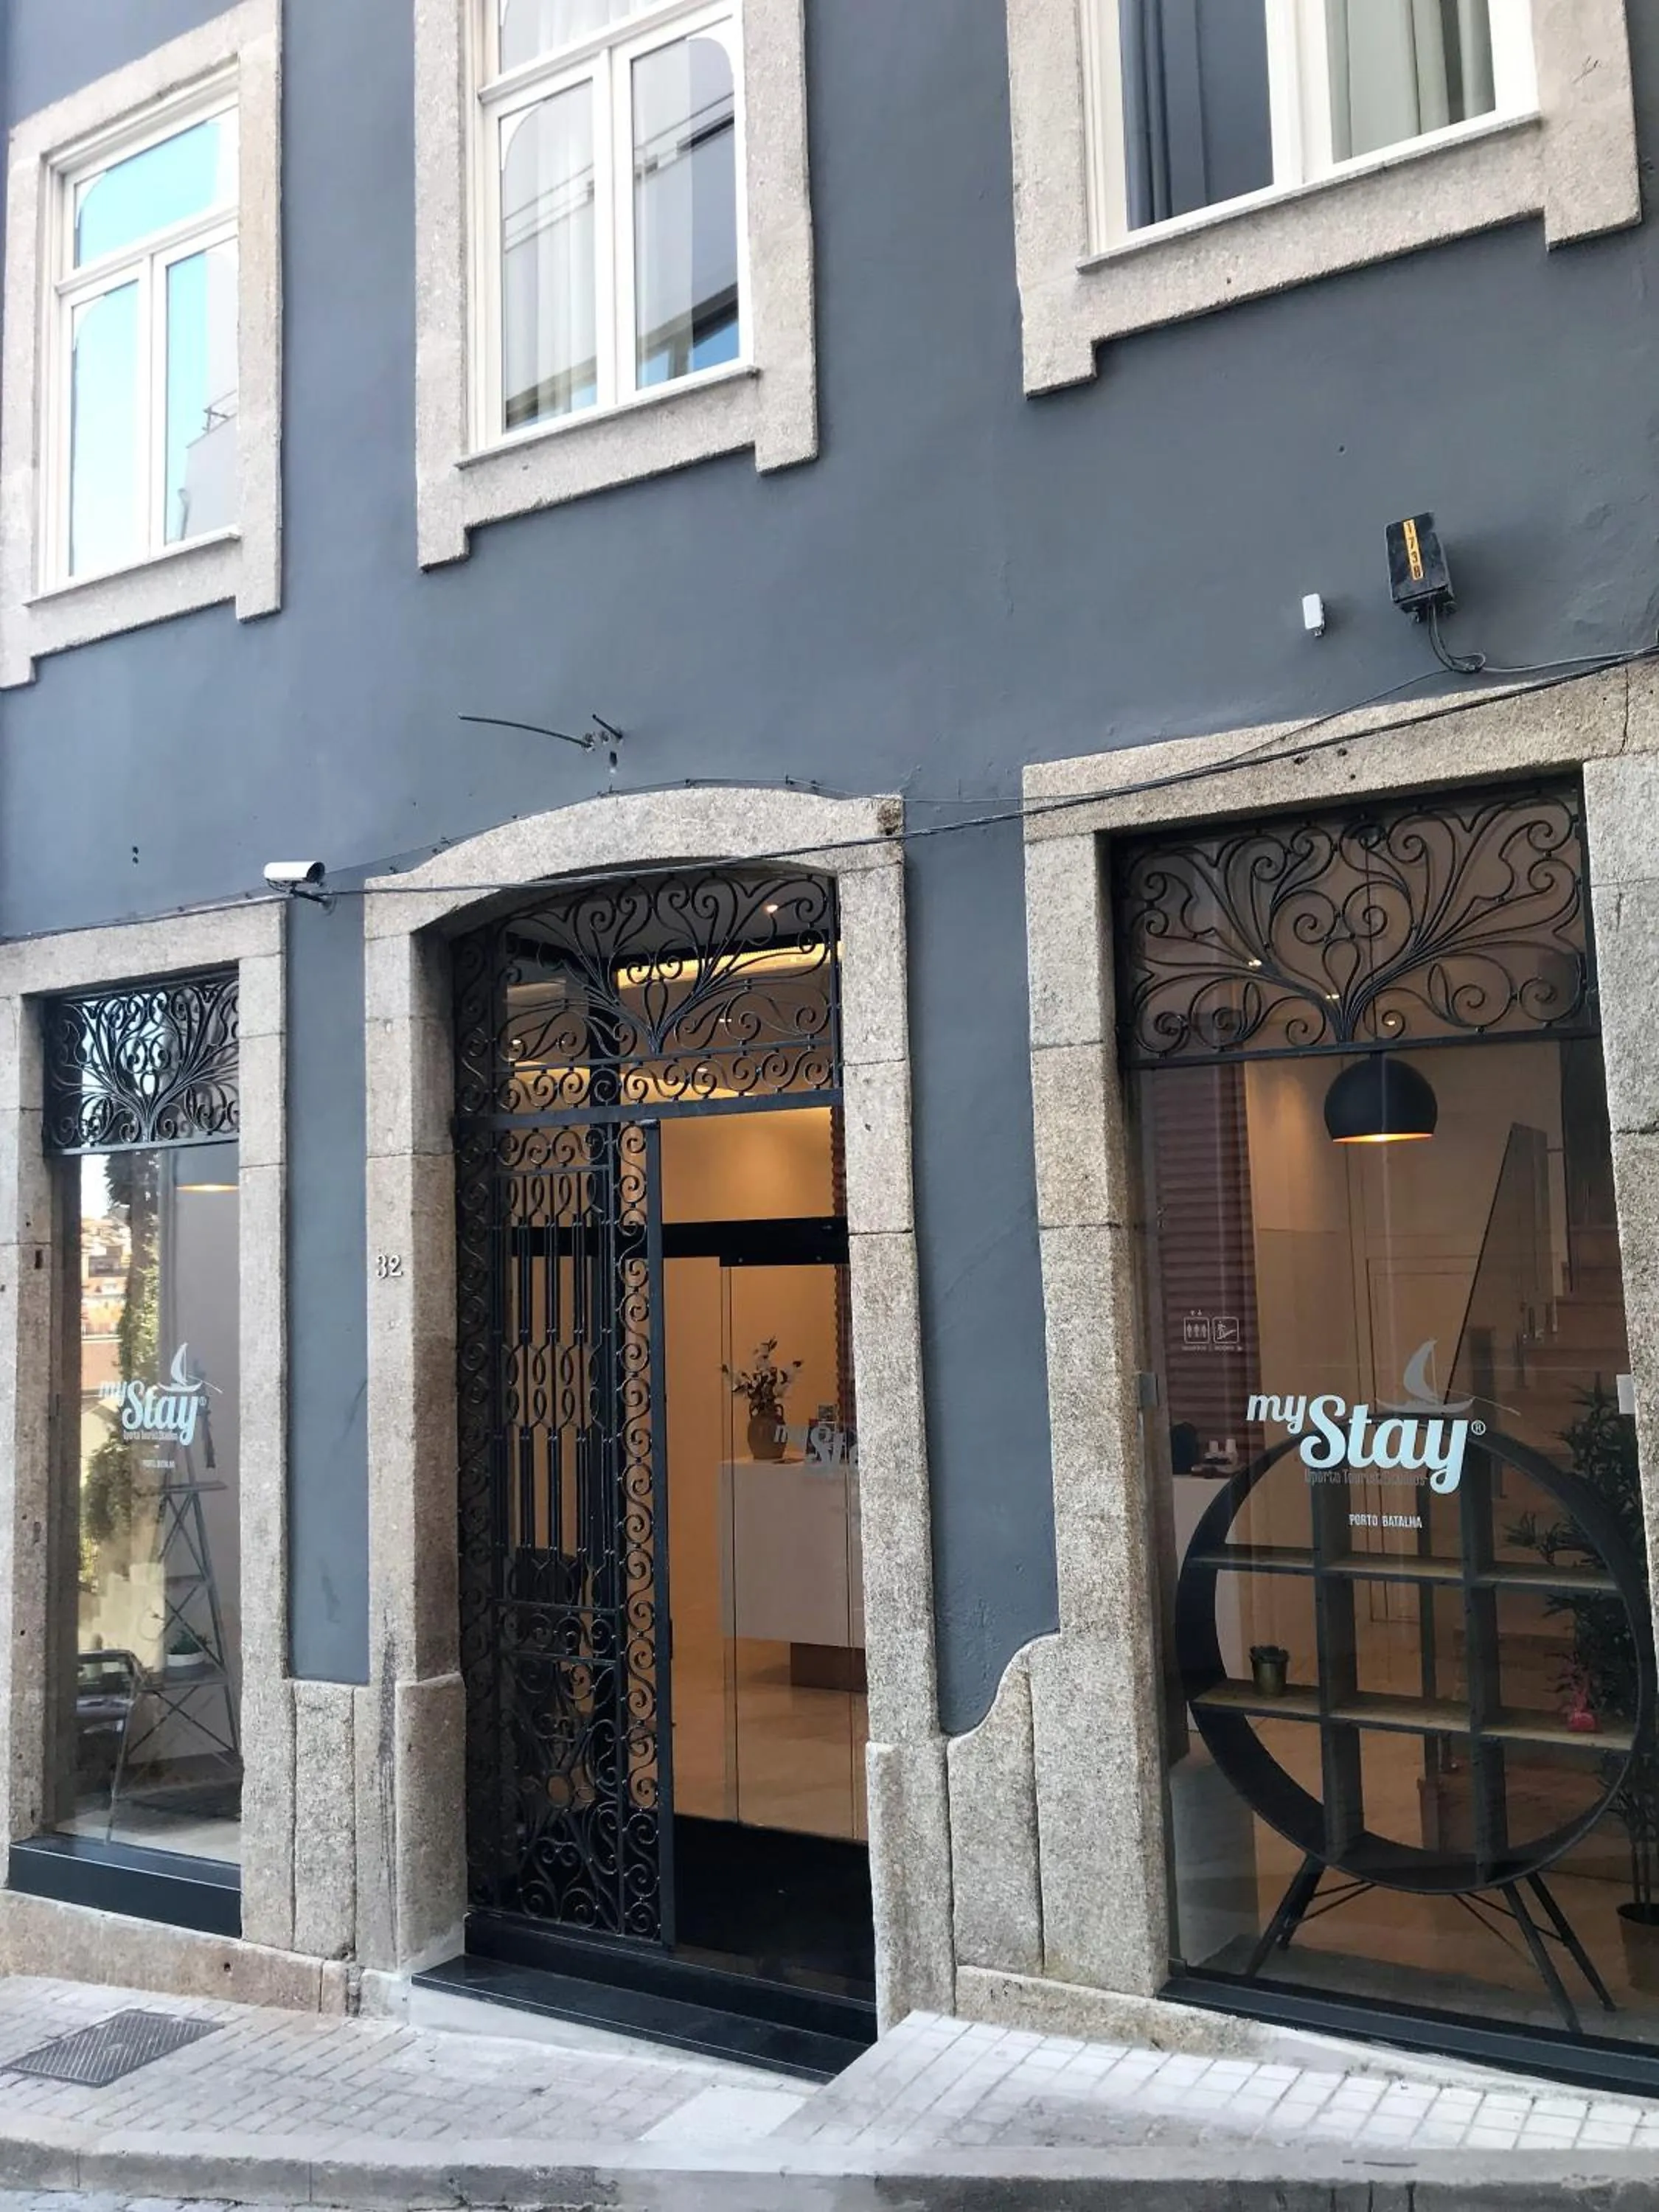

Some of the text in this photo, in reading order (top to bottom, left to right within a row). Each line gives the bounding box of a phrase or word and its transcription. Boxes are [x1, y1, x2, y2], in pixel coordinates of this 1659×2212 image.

[376, 1254, 403, 1279] 32
[1349, 1514, 1422, 1528] PORTO BATALHA
